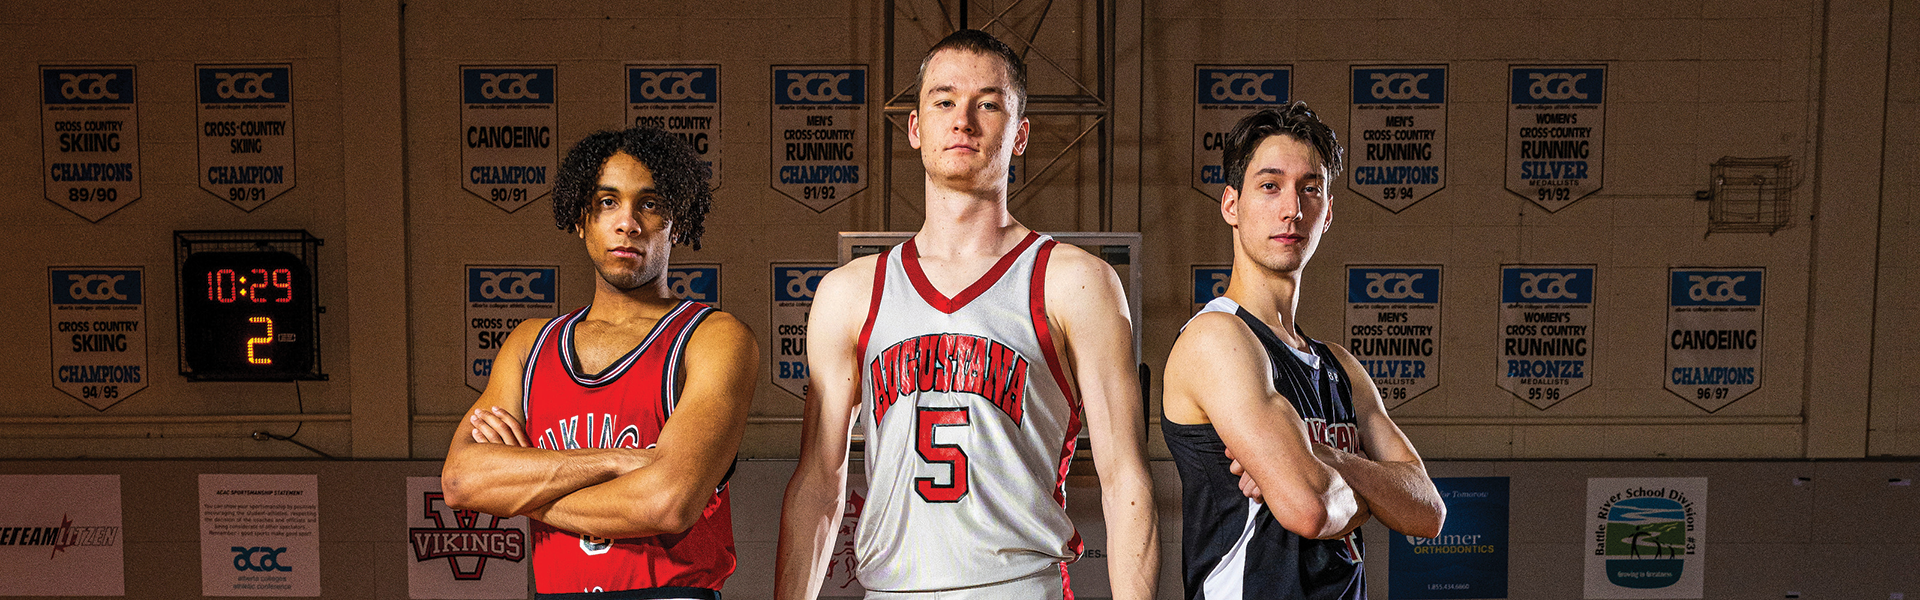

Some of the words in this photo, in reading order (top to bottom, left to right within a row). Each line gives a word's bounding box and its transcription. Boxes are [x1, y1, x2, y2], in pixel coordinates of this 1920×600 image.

[55, 122, 82, 132] CROSS
[84, 121, 123, 132] COUNTRY
[636, 116, 664, 129] CROSS
[668, 116, 712, 129] COUNTRY
[807, 116, 832, 126] MEN'S
[1386, 116, 1414, 126] MEN'S
[1536, 114, 1577, 124] WOMEN'S
[204, 121, 286, 136] CROSS-COUNTRY
[784, 130, 855, 140] CROSS-COUNTRY
[1520, 128, 1592, 138] CROSS-COUNTRY
[60, 133, 120, 152] SKIING
[468, 126, 550, 148] CANOEING
[230, 139, 262, 153] SKIING
[786, 143, 853, 160] RUNNING
[1367, 143, 1431, 160] RUNNING
[1522, 141, 1589, 158] RUNNING
[51, 163, 132, 182] CHAMPIONS
[208, 166, 284, 184] CHAMPION
[470, 166, 546, 184] CHAMPION
[780, 166, 859, 184] CHAMPIONS
[1355, 166, 1438, 184] CHAMPIONS
[1522, 161, 1588, 179] SILVER
[69, 188, 117, 202] 89/90
[230, 188, 266, 200] 90/91
[492, 188, 526, 201] 90/91
[804, 186, 835, 199] 91/92
[1384, 187, 1413, 199] 93/94
[1538, 188, 1570, 200] 91/92
[208, 268, 292, 303] 10:29
[472, 318, 502, 328] CROSS
[1378, 312, 1408, 322] MEN'S
[1524, 312, 1570, 322] WOMEN'S
[58, 322, 89, 332] CROSS
[94, 321, 138, 332] COUNTRY
[1506, 326, 1536, 336] CROSS
[1541, 326, 1587, 336] COUNTRY
[72, 334, 127, 352] SKIING
[248, 316, 272, 364] 2
[1351, 338, 1432, 356] RUNNING
[1505, 338, 1586, 356] RUNNING
[1672, 330, 1756, 349] CANOEING
[58, 366, 140, 382] CHAMPIONS
[1508, 360, 1584, 378] BRONZE
[1672, 367, 1754, 384] CHAMPIONS
[870, 332, 1028, 428] AUGUSTANA
[82, 386, 118, 398] 94/95
[1529, 388, 1560, 400] 95/96
[1698, 388, 1728, 399] 96/97
[915, 406, 969, 503] 5
[1626, 487, 1664, 498] School
[1598, 492, 1620, 520] River
[1669, 490, 1696, 532] Division
[414, 530, 522, 558] VIKINGS
[1595, 524, 1606, 556] Battle
[1686, 537, 1696, 555] #31
[1414, 545, 1494, 554] ORTHODONTICS
